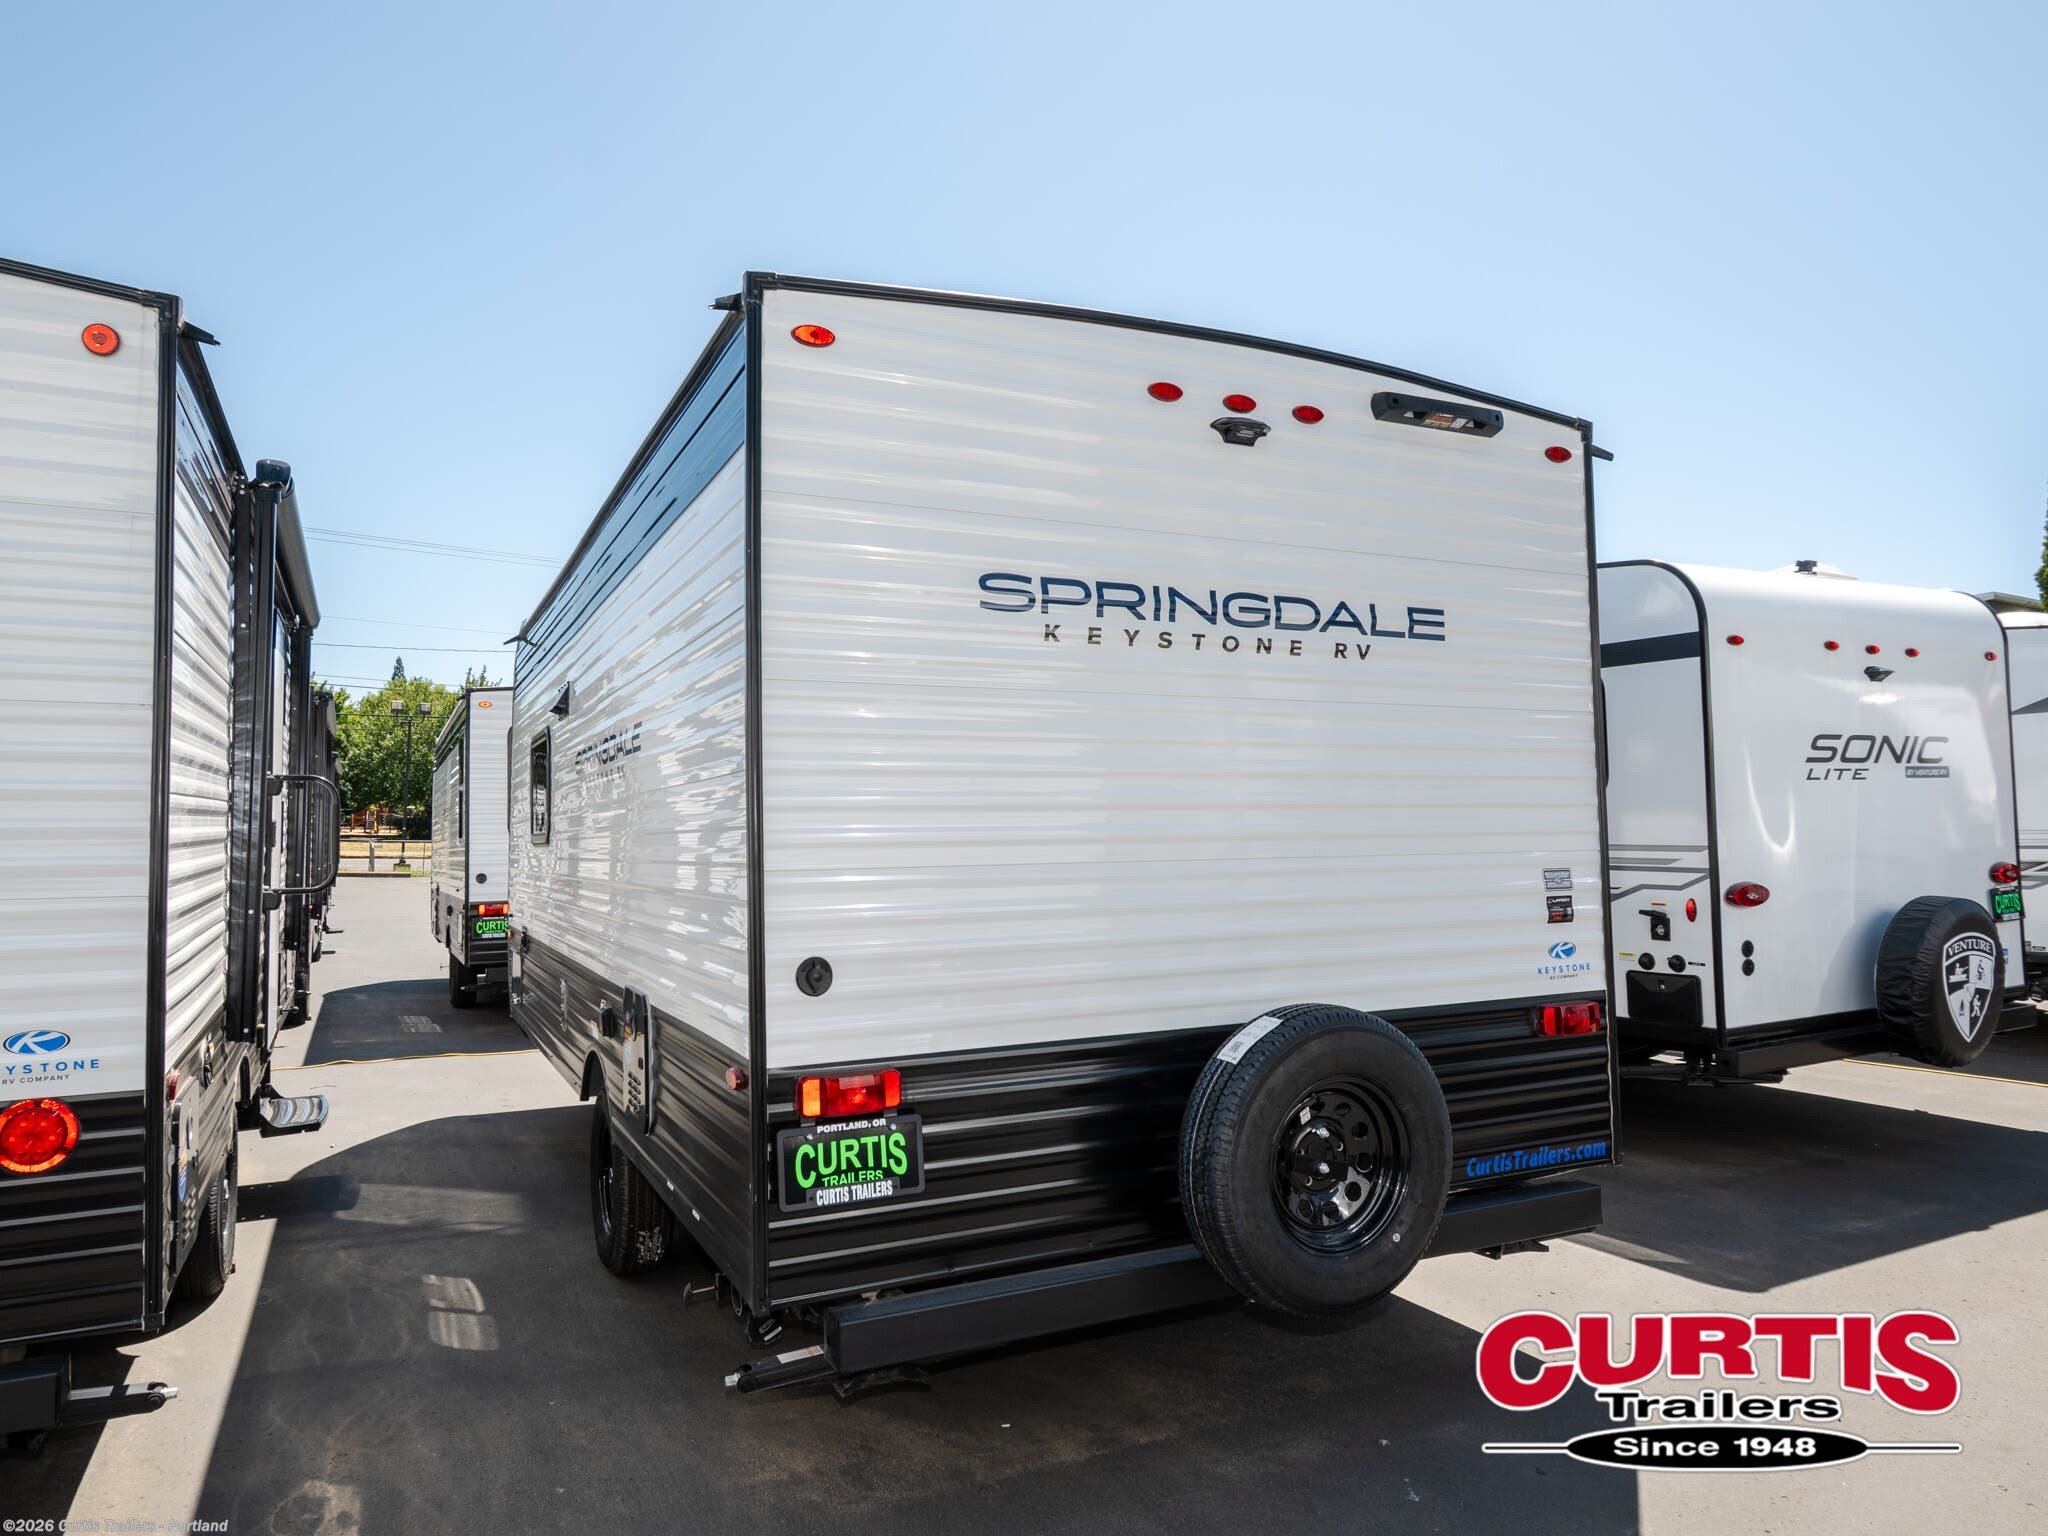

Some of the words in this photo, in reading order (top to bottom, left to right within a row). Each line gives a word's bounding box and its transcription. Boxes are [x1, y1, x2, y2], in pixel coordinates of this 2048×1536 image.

[978, 572, 1446, 642] SPRINGDALE
[1044, 623, 1302, 657] KEYSTONE
[1334, 642, 1371, 660] RV
[1805, 734, 1950, 764] SONIC
[1806, 768, 1870, 780] LITE
[1995, 893, 2022, 914] CURTIS
[476, 921, 509, 934] CURTIS
[1948, 938, 1992, 956] VENTURE
[1537, 963, 1591, 975] KEYSTONE
[4, 1059, 100, 1076] YSTONE
[19, 1074, 71, 1084] COMPANY
[816, 1120, 872, 1134] PORTLAND,
[872, 1118, 887, 1127] OR
[795, 1132, 908, 1189] CURTIS
[1465, 1142, 1606, 1177] CurtisTrailers.com
[822, 1169, 884, 1187] TRAILERS
[816, 1186, 850, 1206] CURTIS
[851, 1180, 893, 1201] TRAILERS
